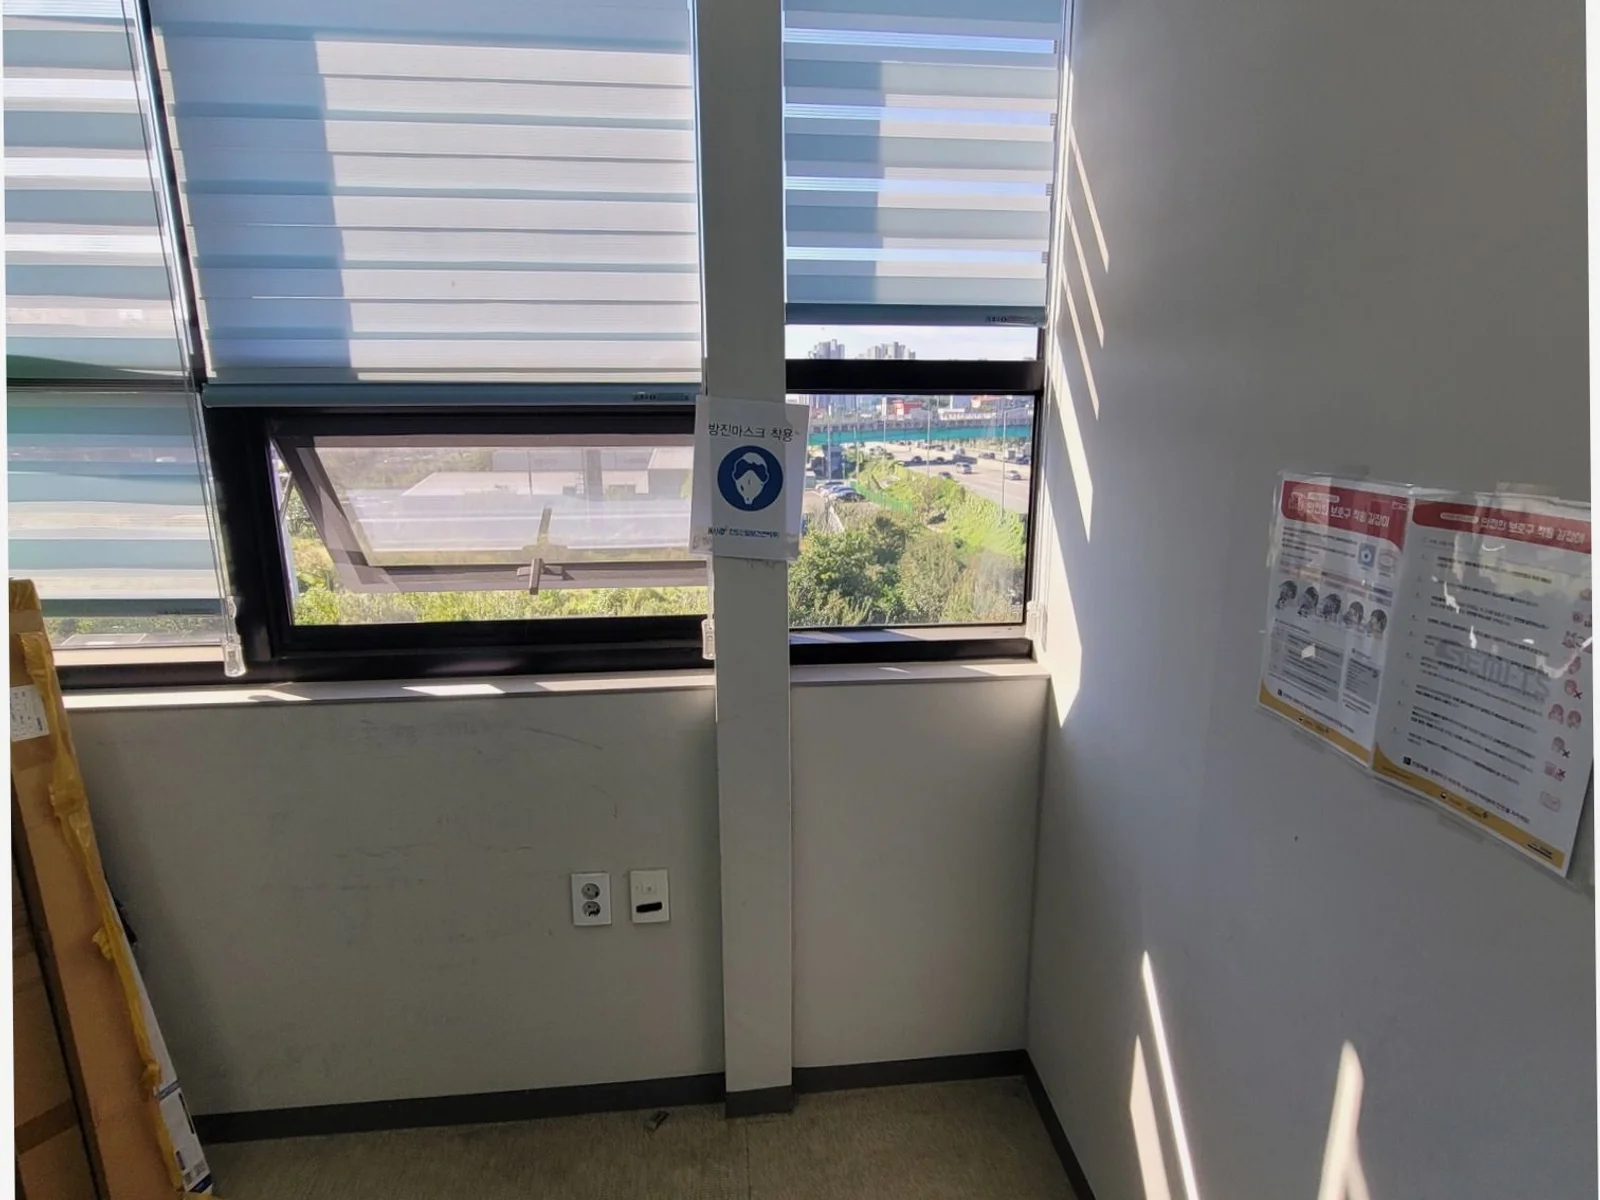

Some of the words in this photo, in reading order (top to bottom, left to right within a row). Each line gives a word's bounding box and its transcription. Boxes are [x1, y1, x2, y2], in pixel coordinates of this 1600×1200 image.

[708, 423, 766, 439] 방진마스크
[770, 428, 794, 443] 착용
[1330, 504, 1351, 519] 보호구
[1368, 512, 1390, 528] 길잡이
[1508, 520, 1535, 535] 보호구
[1556, 528, 1585, 544] 길잡이
